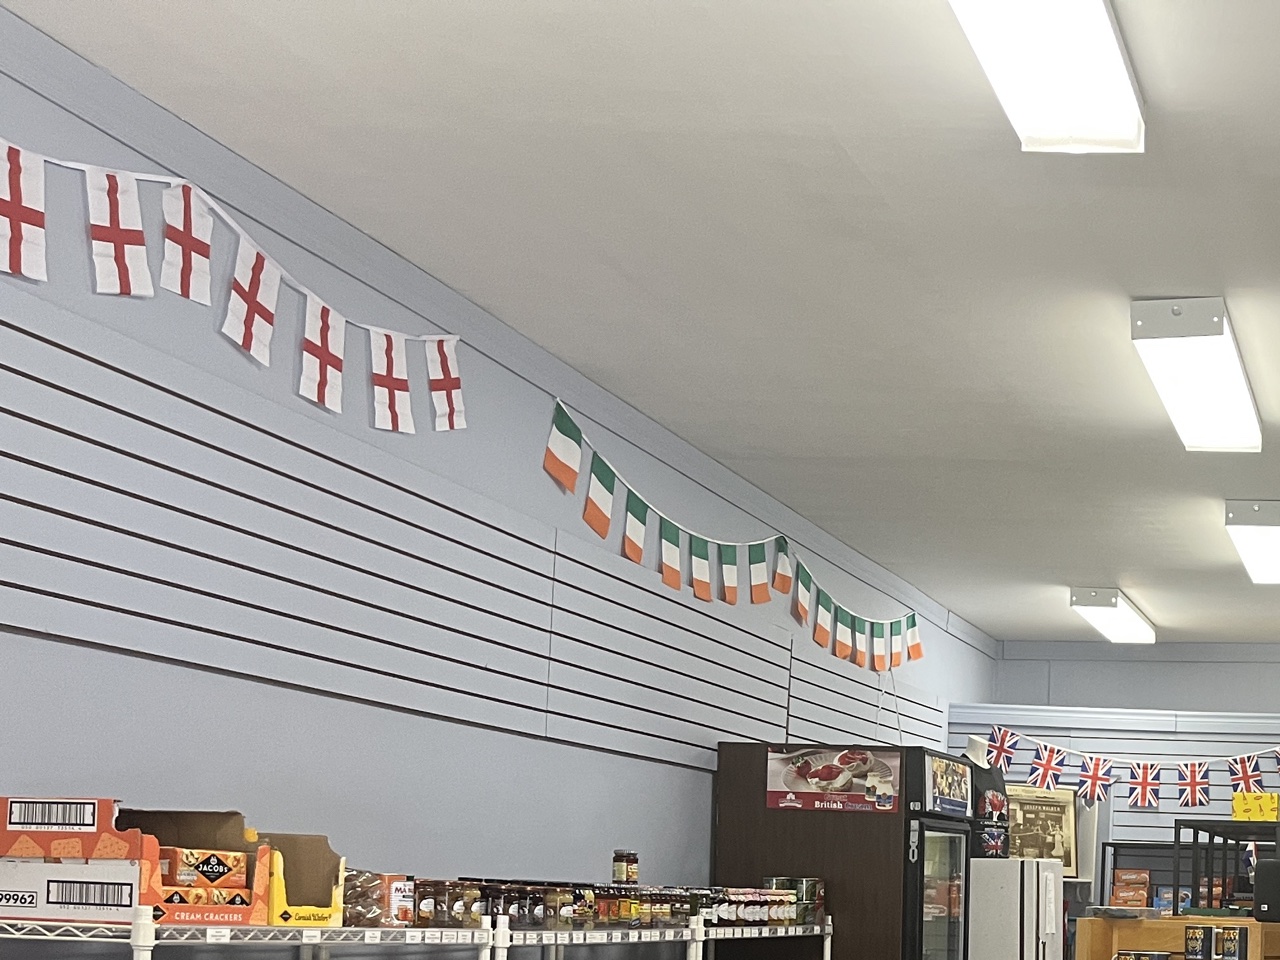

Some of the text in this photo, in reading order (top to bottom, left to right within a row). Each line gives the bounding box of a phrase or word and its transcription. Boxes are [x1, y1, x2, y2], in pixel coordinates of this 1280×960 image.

[814, 801, 843, 810] British
[174, 912, 242, 922] CREAM CRACKERS
